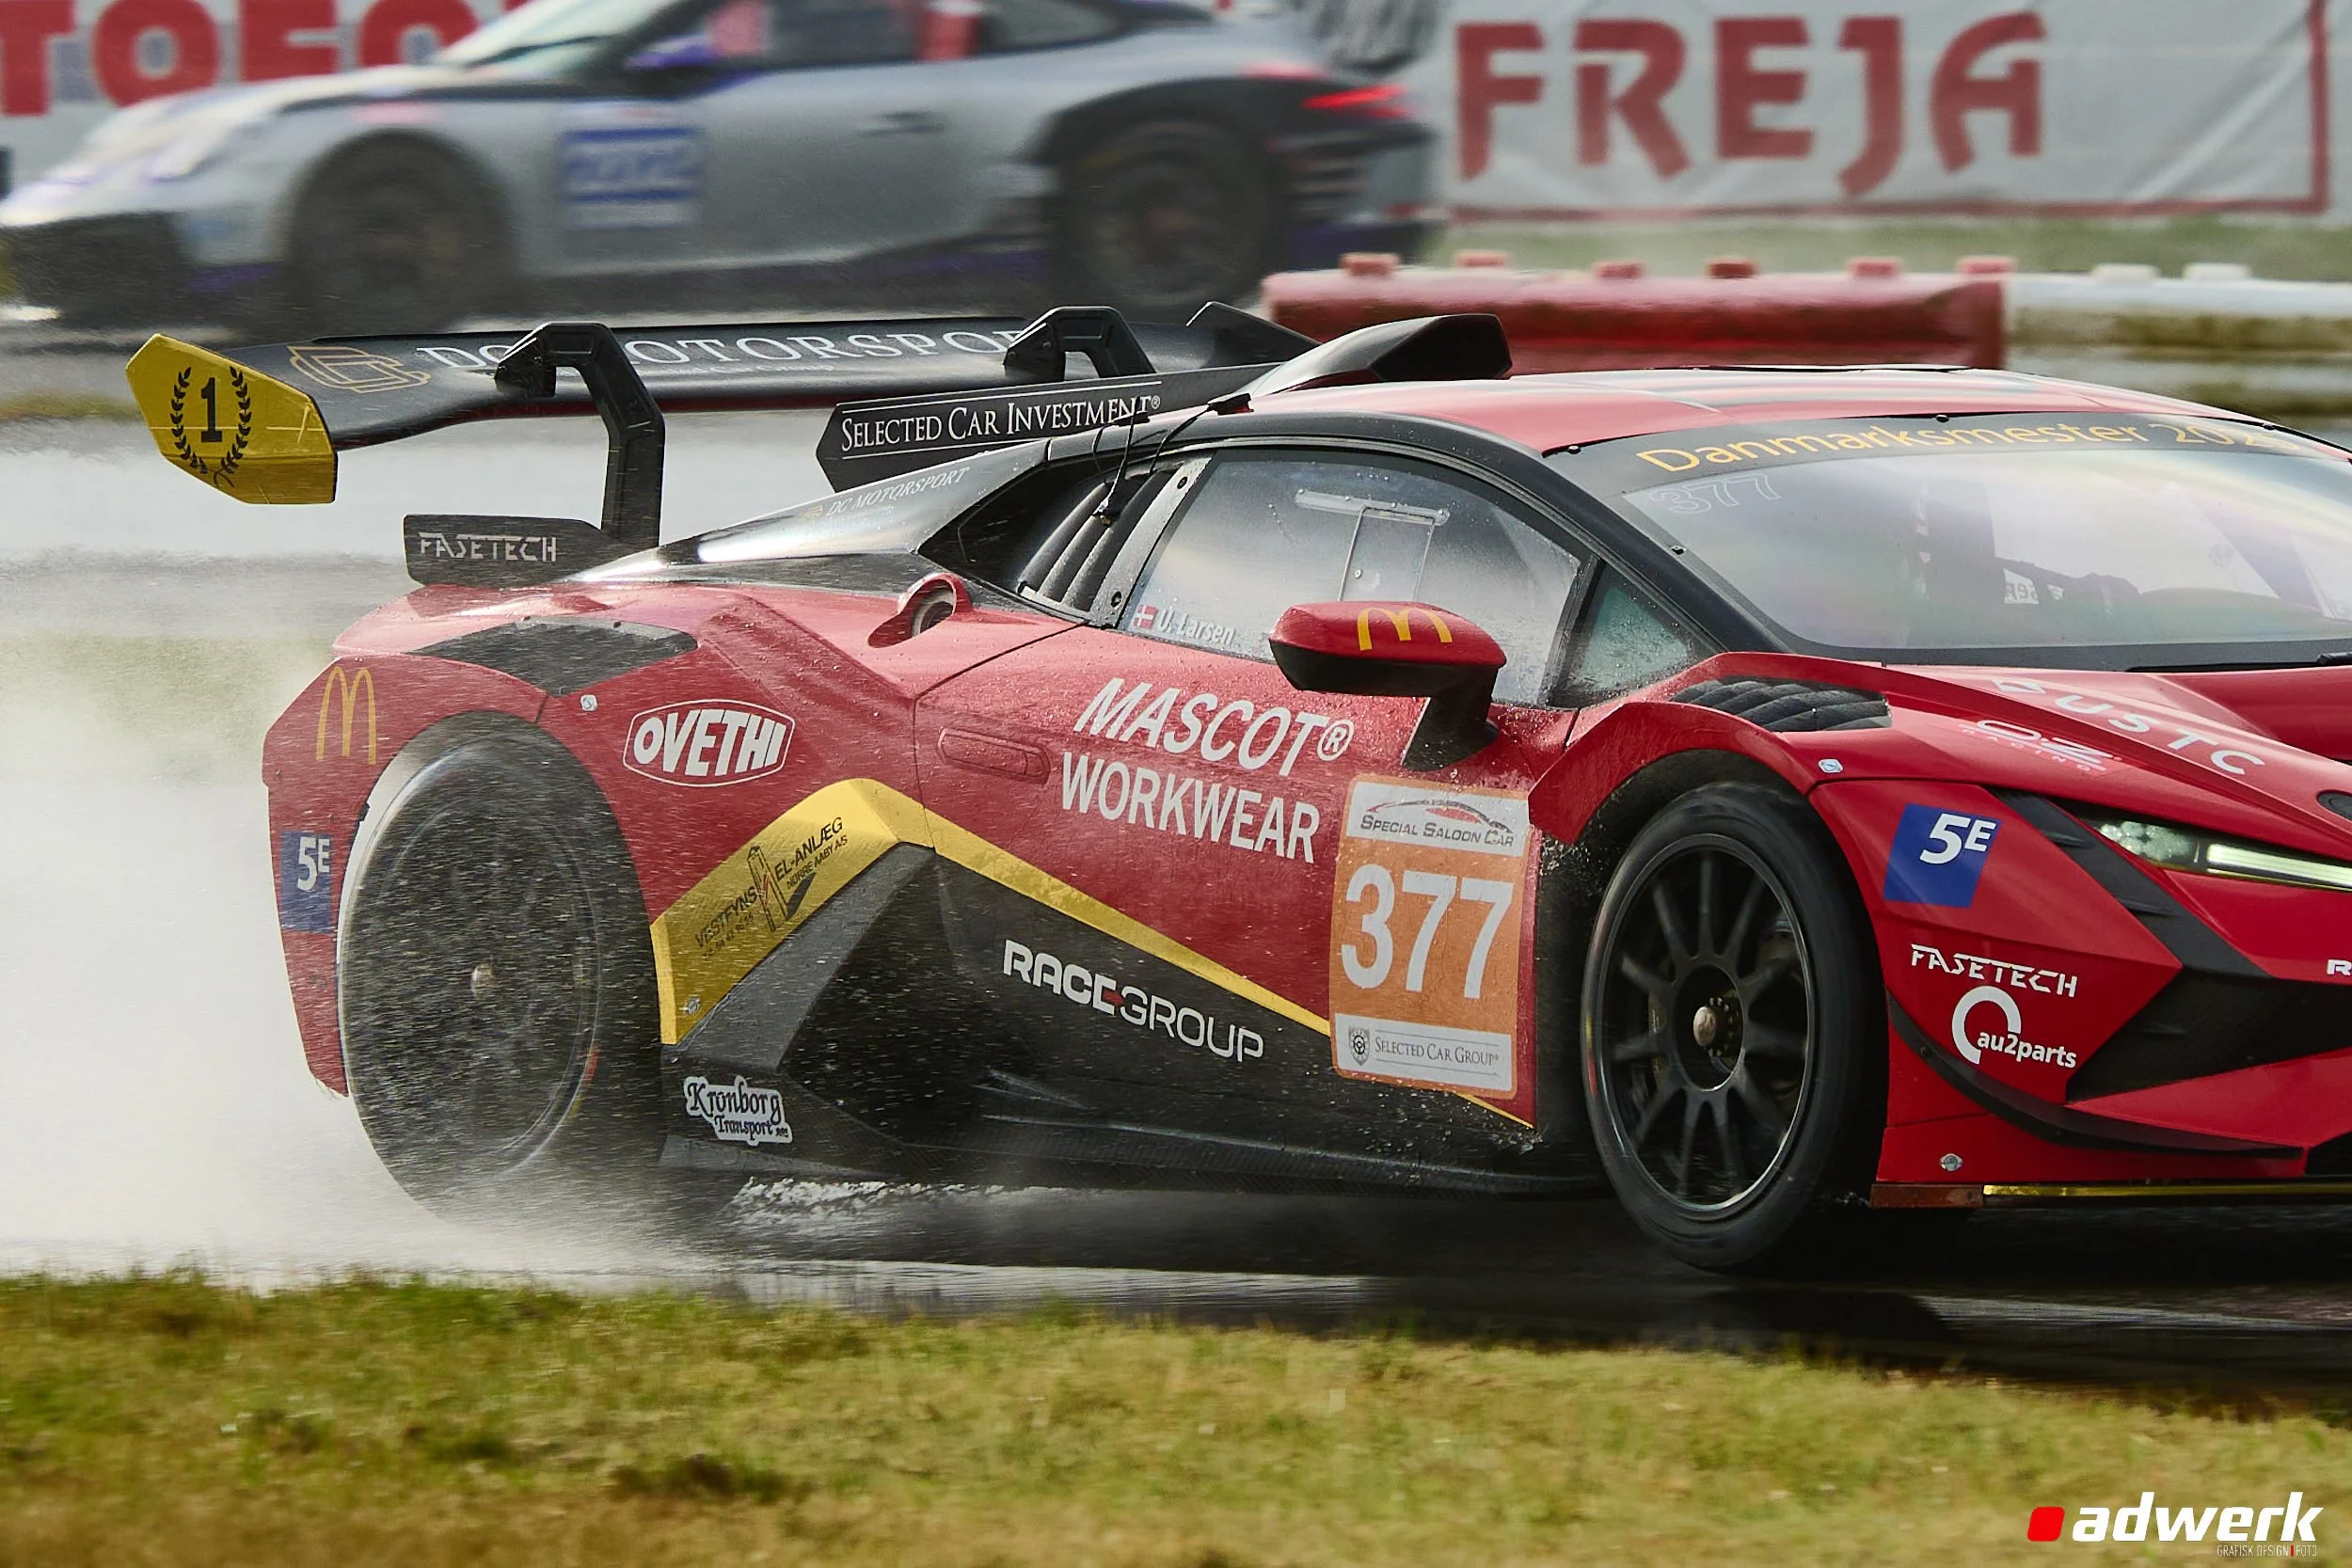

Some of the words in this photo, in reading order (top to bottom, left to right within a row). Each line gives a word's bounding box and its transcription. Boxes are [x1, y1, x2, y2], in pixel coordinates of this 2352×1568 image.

[1455, 10, 2046, 198] FREJA
[628, 330, 1024, 365] OTORSPO
[200, 377, 223, 443] 1
[1636, 423, 2149, 472] Danmarksmester
[850, 467, 970, 510] MOTORSPORT
[1649, 472, 1781, 515] 377
[419, 531, 557, 562] FASETECH
[1180, 612, 1236, 646] Larsen
[633, 708, 787, 776] OVETHI
[1061, 752, 1320, 863] WORKWEAR
[1339, 863, 1515, 1000] 377
[1911, 943, 2078, 998] FASETECH
[1977, 1031, 2077, 1069] au2parts
[687, 1081, 782, 1125] Kronborg
[714, 1114, 773, 1141] Transport
